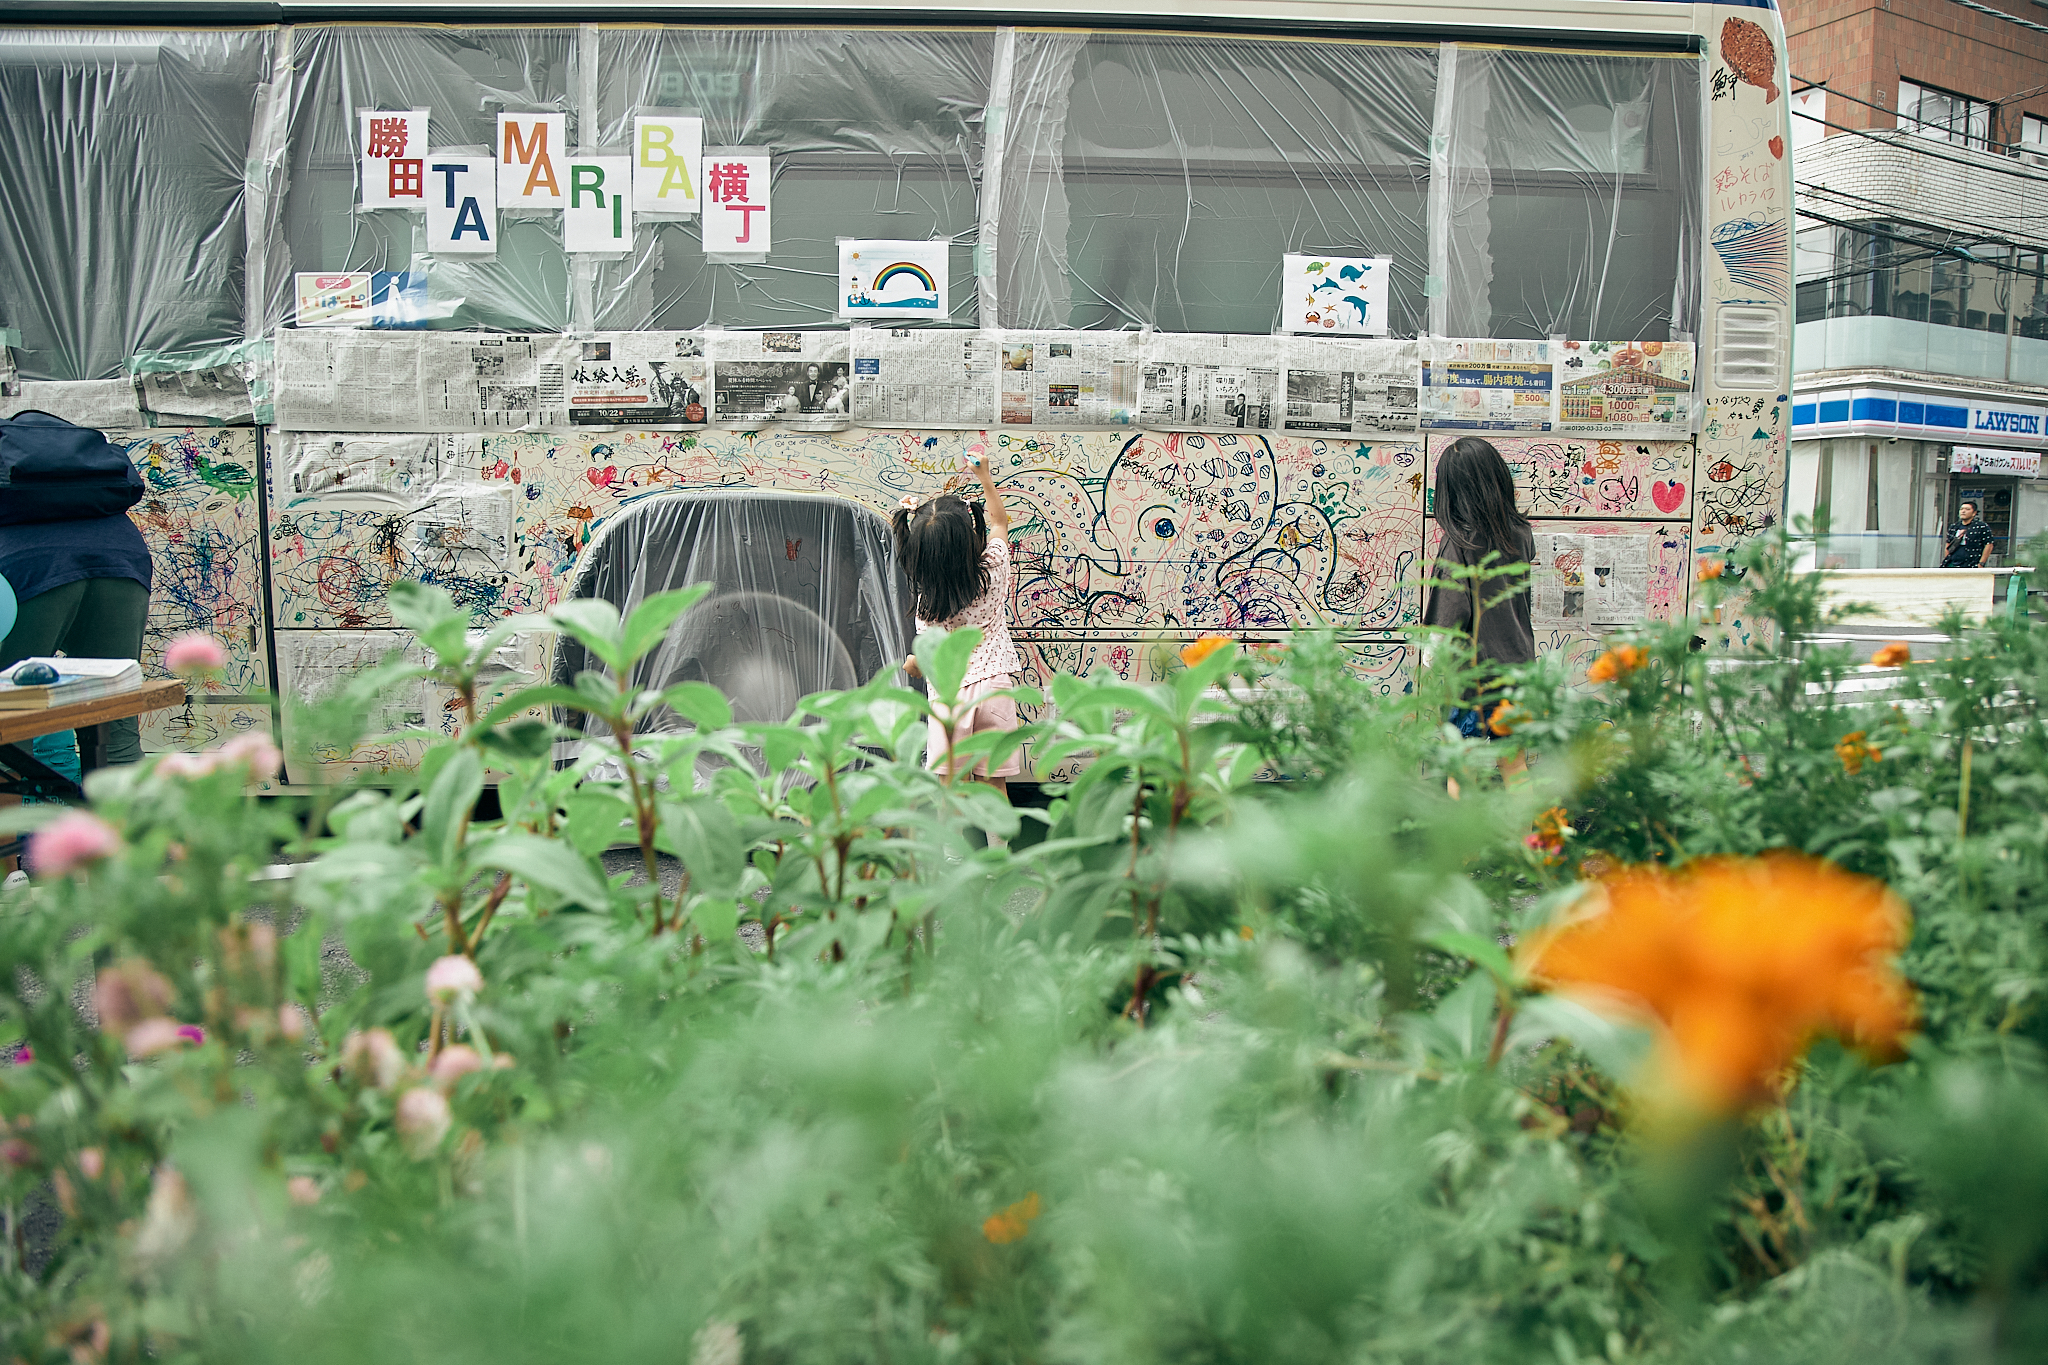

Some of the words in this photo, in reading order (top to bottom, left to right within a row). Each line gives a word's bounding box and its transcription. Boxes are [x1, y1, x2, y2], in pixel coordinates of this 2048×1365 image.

[367, 118, 424, 197] 勝田
[709, 162, 766, 243] 横丁
[571, 365, 640, 384] 体験入学
[1975, 410, 2040, 434] LAWSON
